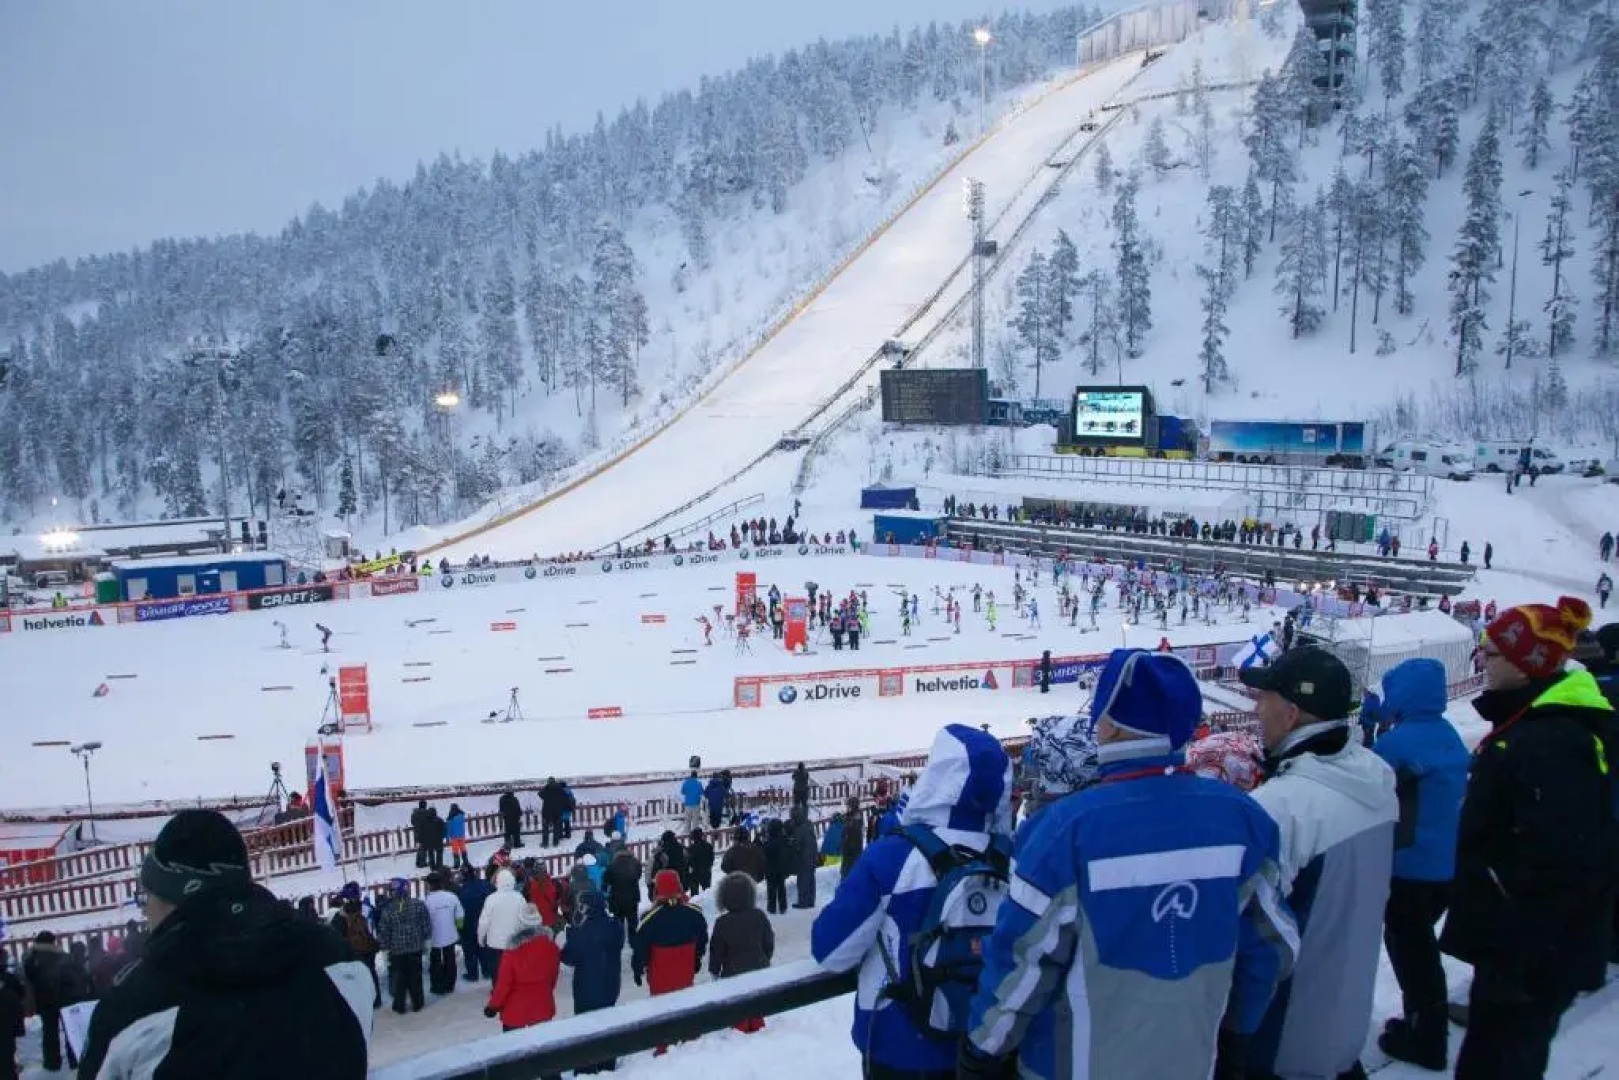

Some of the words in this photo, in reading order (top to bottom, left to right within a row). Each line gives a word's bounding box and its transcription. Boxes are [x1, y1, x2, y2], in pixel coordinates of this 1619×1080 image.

[619, 560, 650, 570] xDrive
[690, 554, 719, 564] xDrive
[543, 566, 577, 578] xDrive
[461, 573, 496, 585] xDrive
[261, 591, 308, 606] CRAFT
[24, 615, 85, 630] helvetia
[916, 675, 979, 692] helvetia
[804, 682, 861, 701] xDrive
